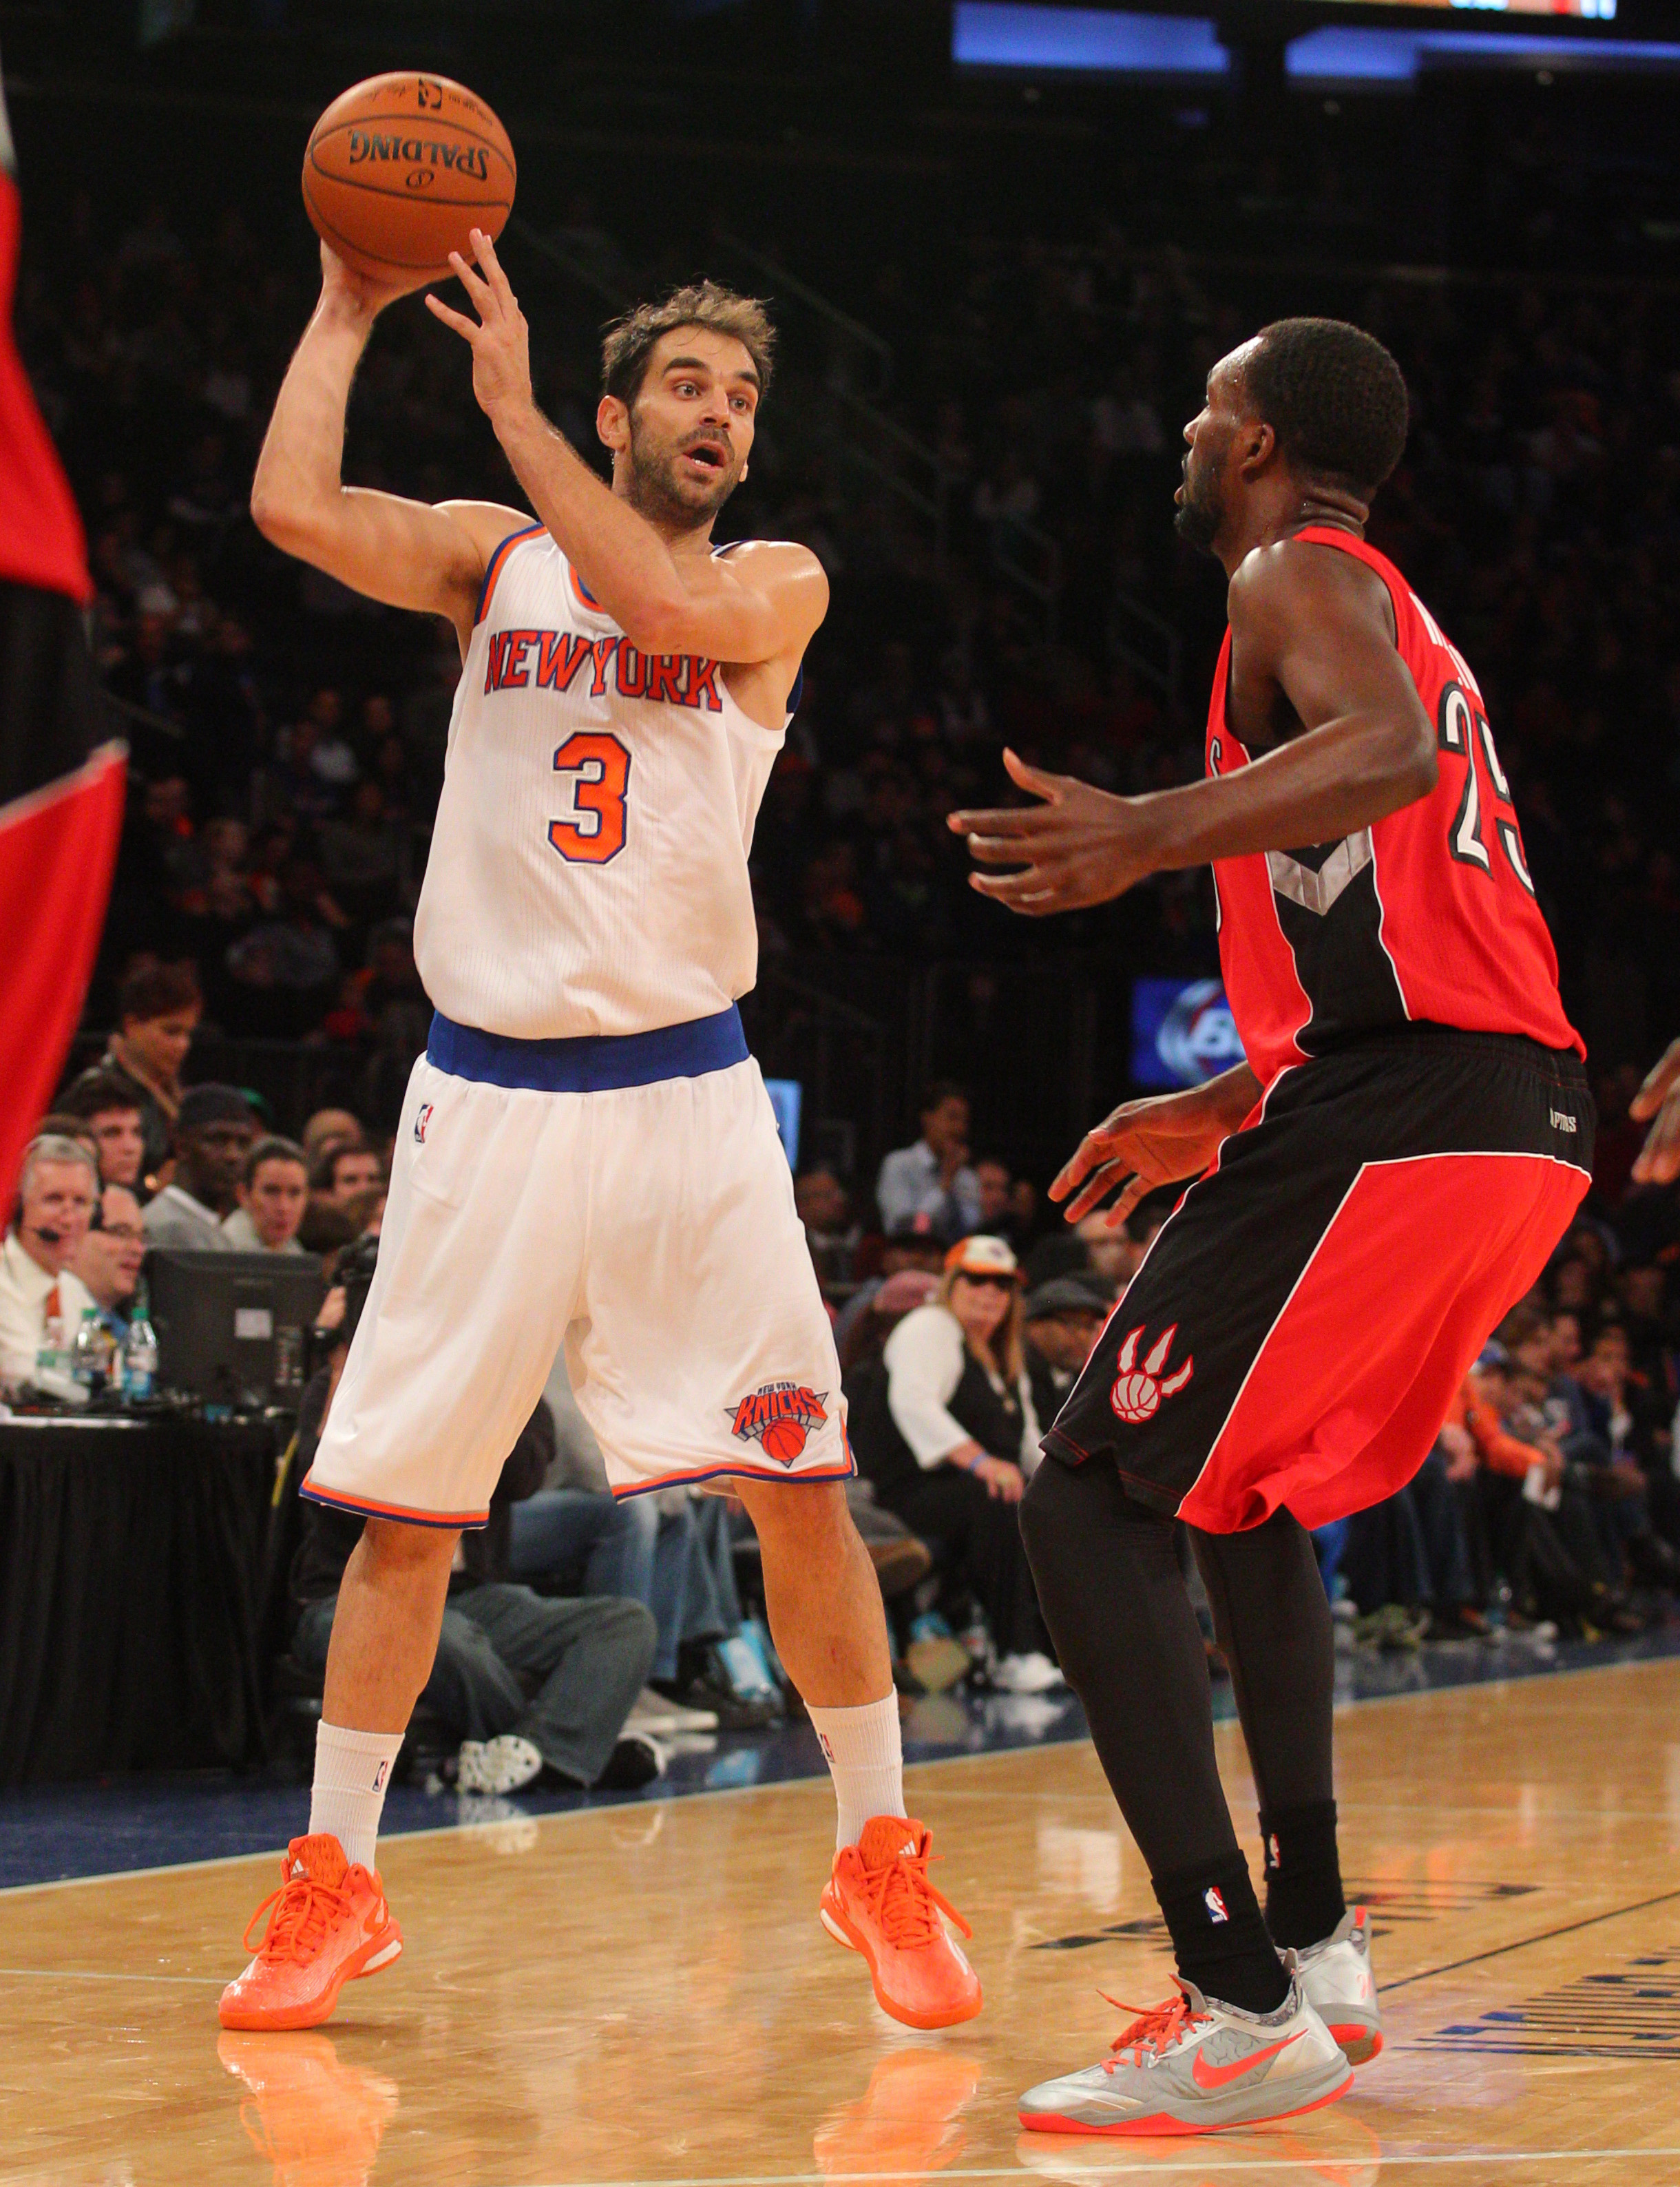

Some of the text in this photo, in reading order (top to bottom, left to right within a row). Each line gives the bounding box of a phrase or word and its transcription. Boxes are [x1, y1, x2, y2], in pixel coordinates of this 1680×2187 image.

[348, 129, 490, 180] SPALDING
[484, 629, 723, 712] NEW YORK
[548, 732, 632, 864] 3
[731, 1386, 828, 1439] KNICKS
